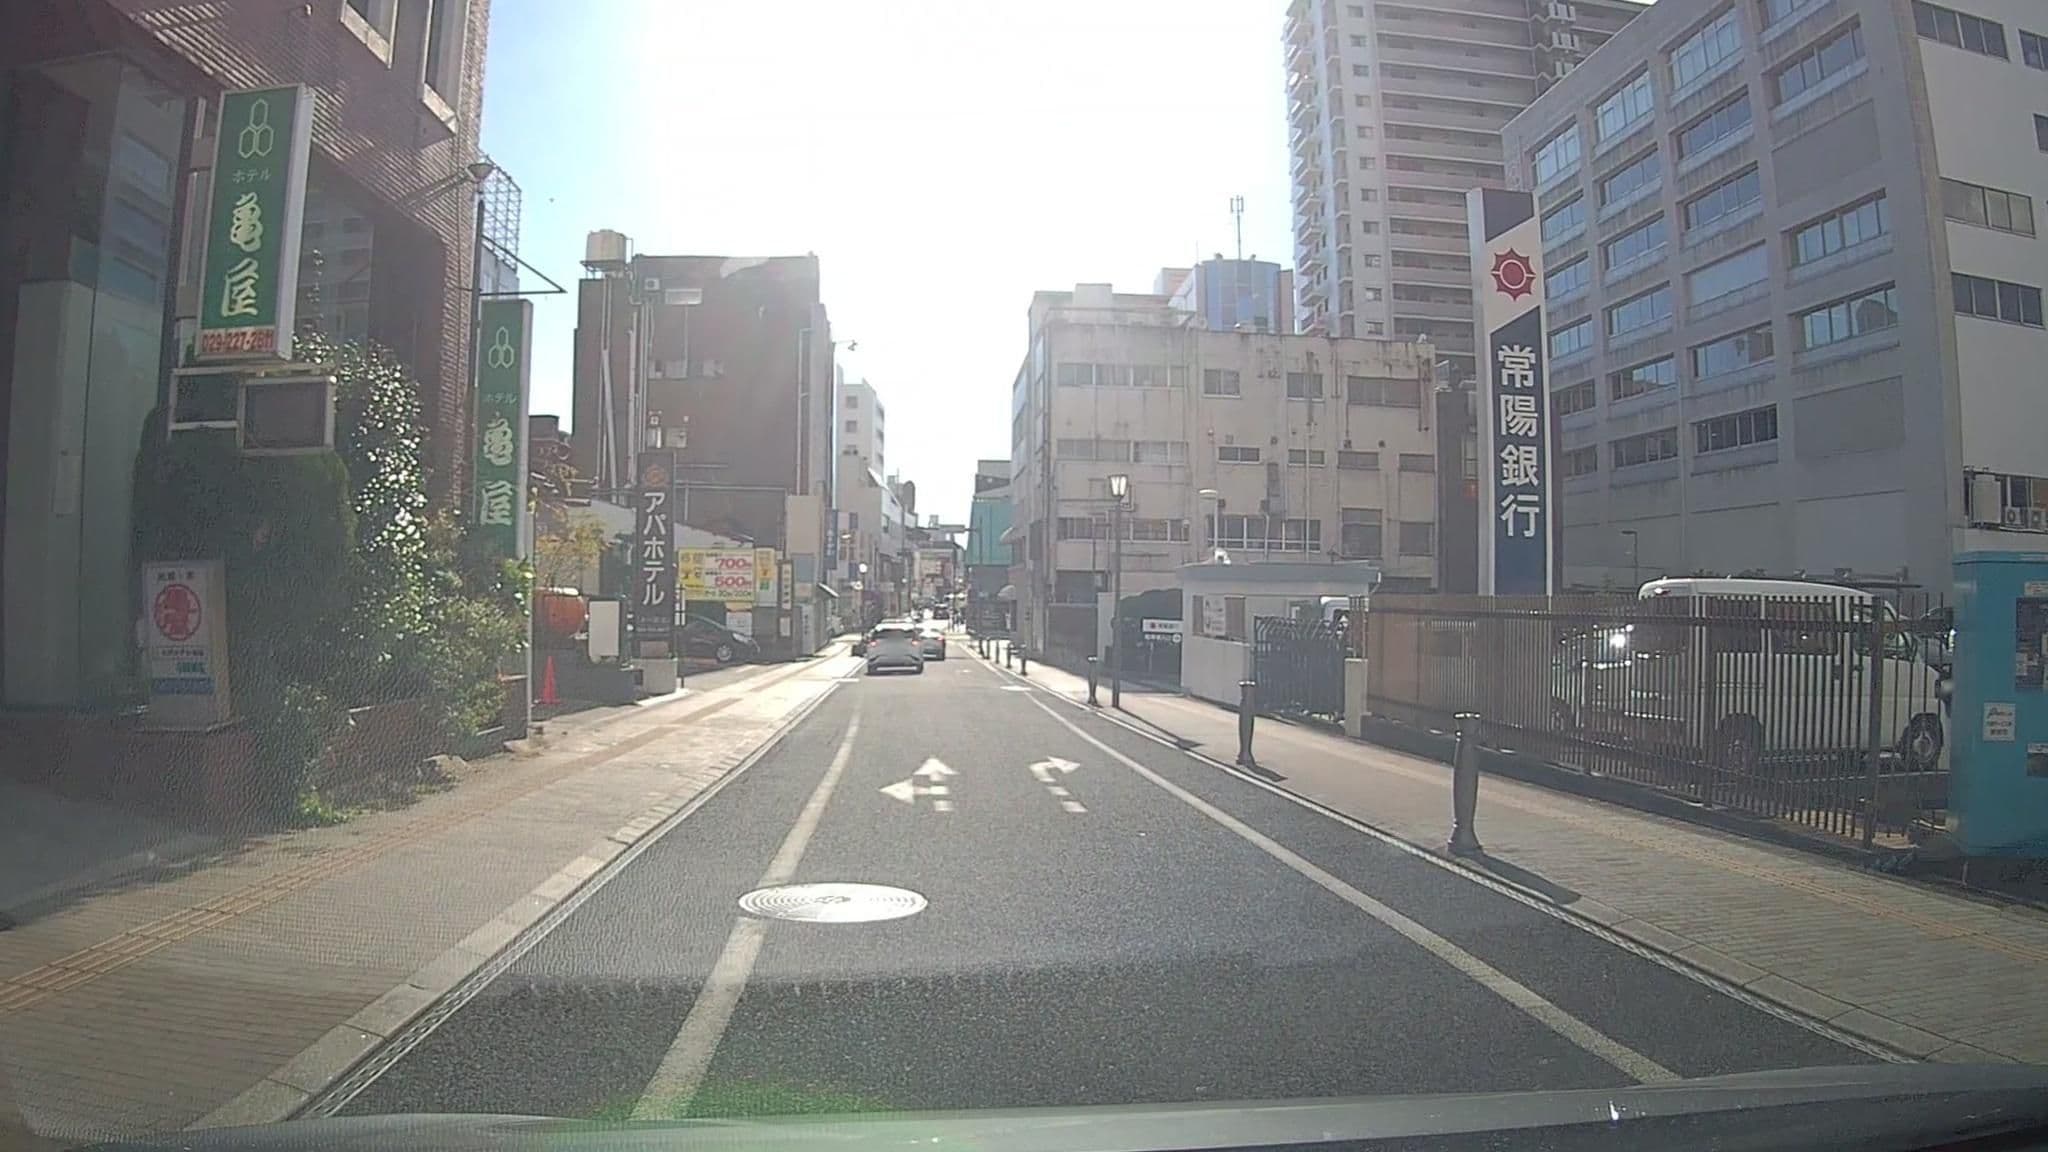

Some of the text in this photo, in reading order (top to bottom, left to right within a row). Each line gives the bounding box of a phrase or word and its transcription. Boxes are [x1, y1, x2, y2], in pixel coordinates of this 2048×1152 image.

[232, 168, 272, 183] ホテル
[221, 191, 264, 317] 亀屋
[479, 412, 514, 526] 亀屋
[1498, 343, 1540, 538] 常陽銀行
[643, 492, 667, 606] アパホテル
